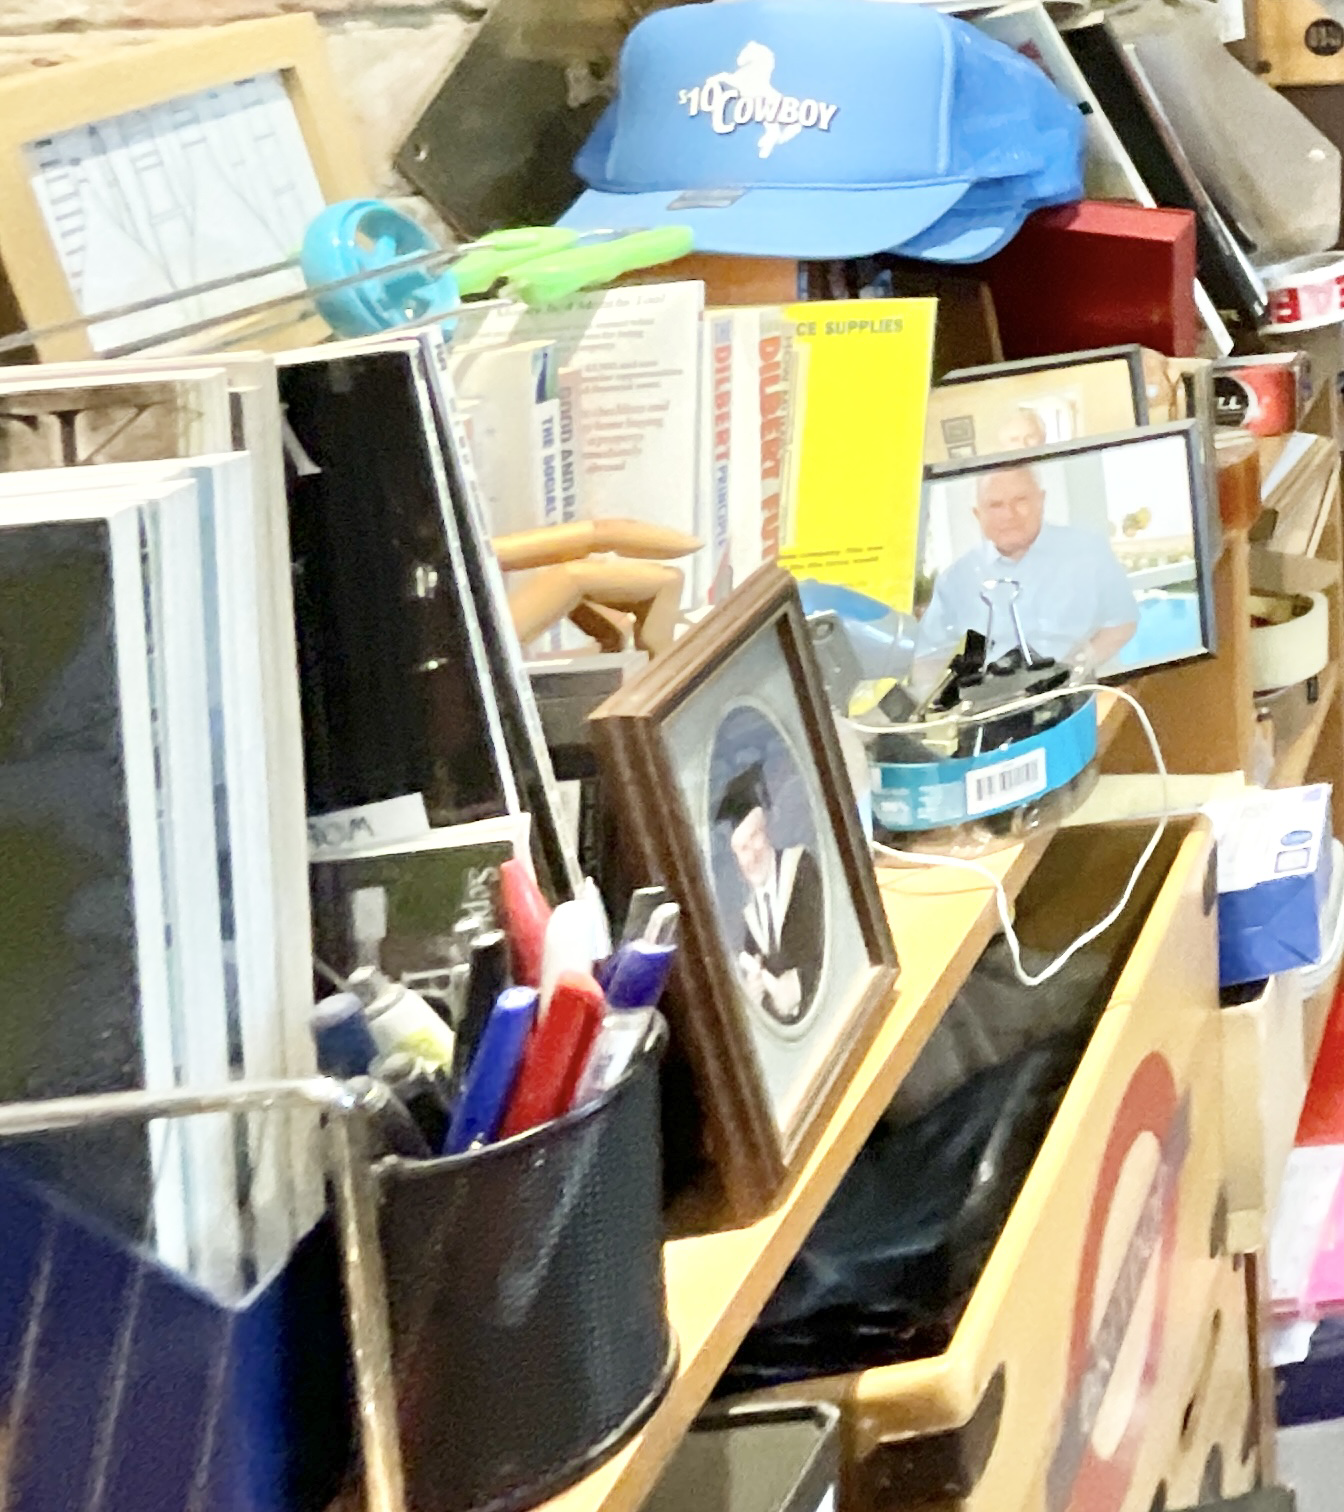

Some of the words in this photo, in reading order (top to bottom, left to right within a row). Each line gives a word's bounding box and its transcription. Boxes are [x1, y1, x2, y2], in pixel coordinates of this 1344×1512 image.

[712, 88, 839, 135] COWBOY
[824, 318, 904, 336] SUPPLIES
[714, 344, 732, 462] DILBERT
[758, 335, 782, 480] DILBERT
[541, 416, 555, 449] THE
[542, 454, 558, 517] SOCIAL
[561, 448, 576, 491] AND
